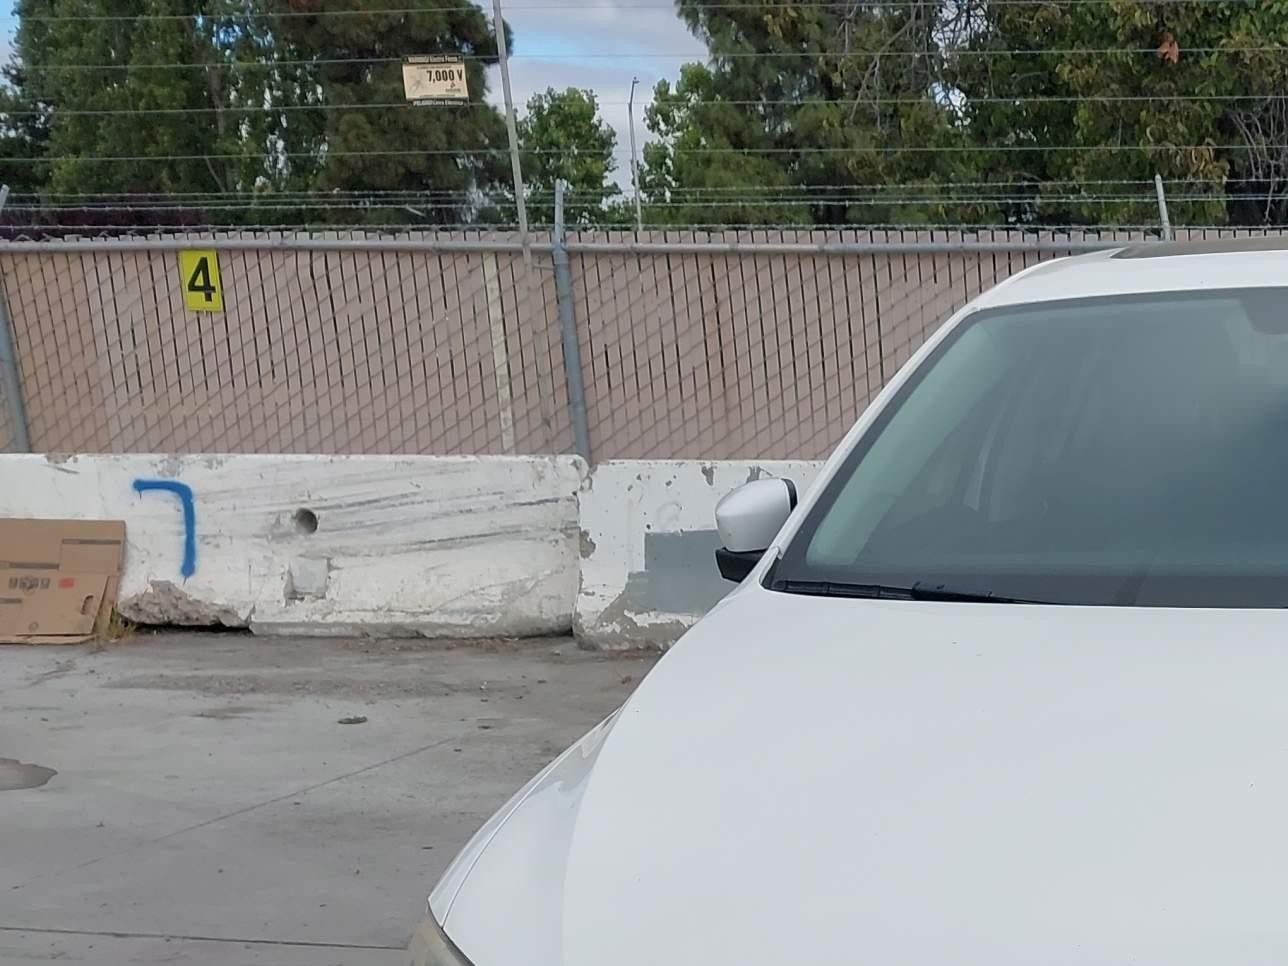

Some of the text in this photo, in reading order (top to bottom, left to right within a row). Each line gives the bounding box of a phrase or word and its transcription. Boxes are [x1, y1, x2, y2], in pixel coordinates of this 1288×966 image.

[426, 69, 463, 83] 7,000 V
[188, 256, 216, 302] 4
[133, 479, 196, 580] 7
